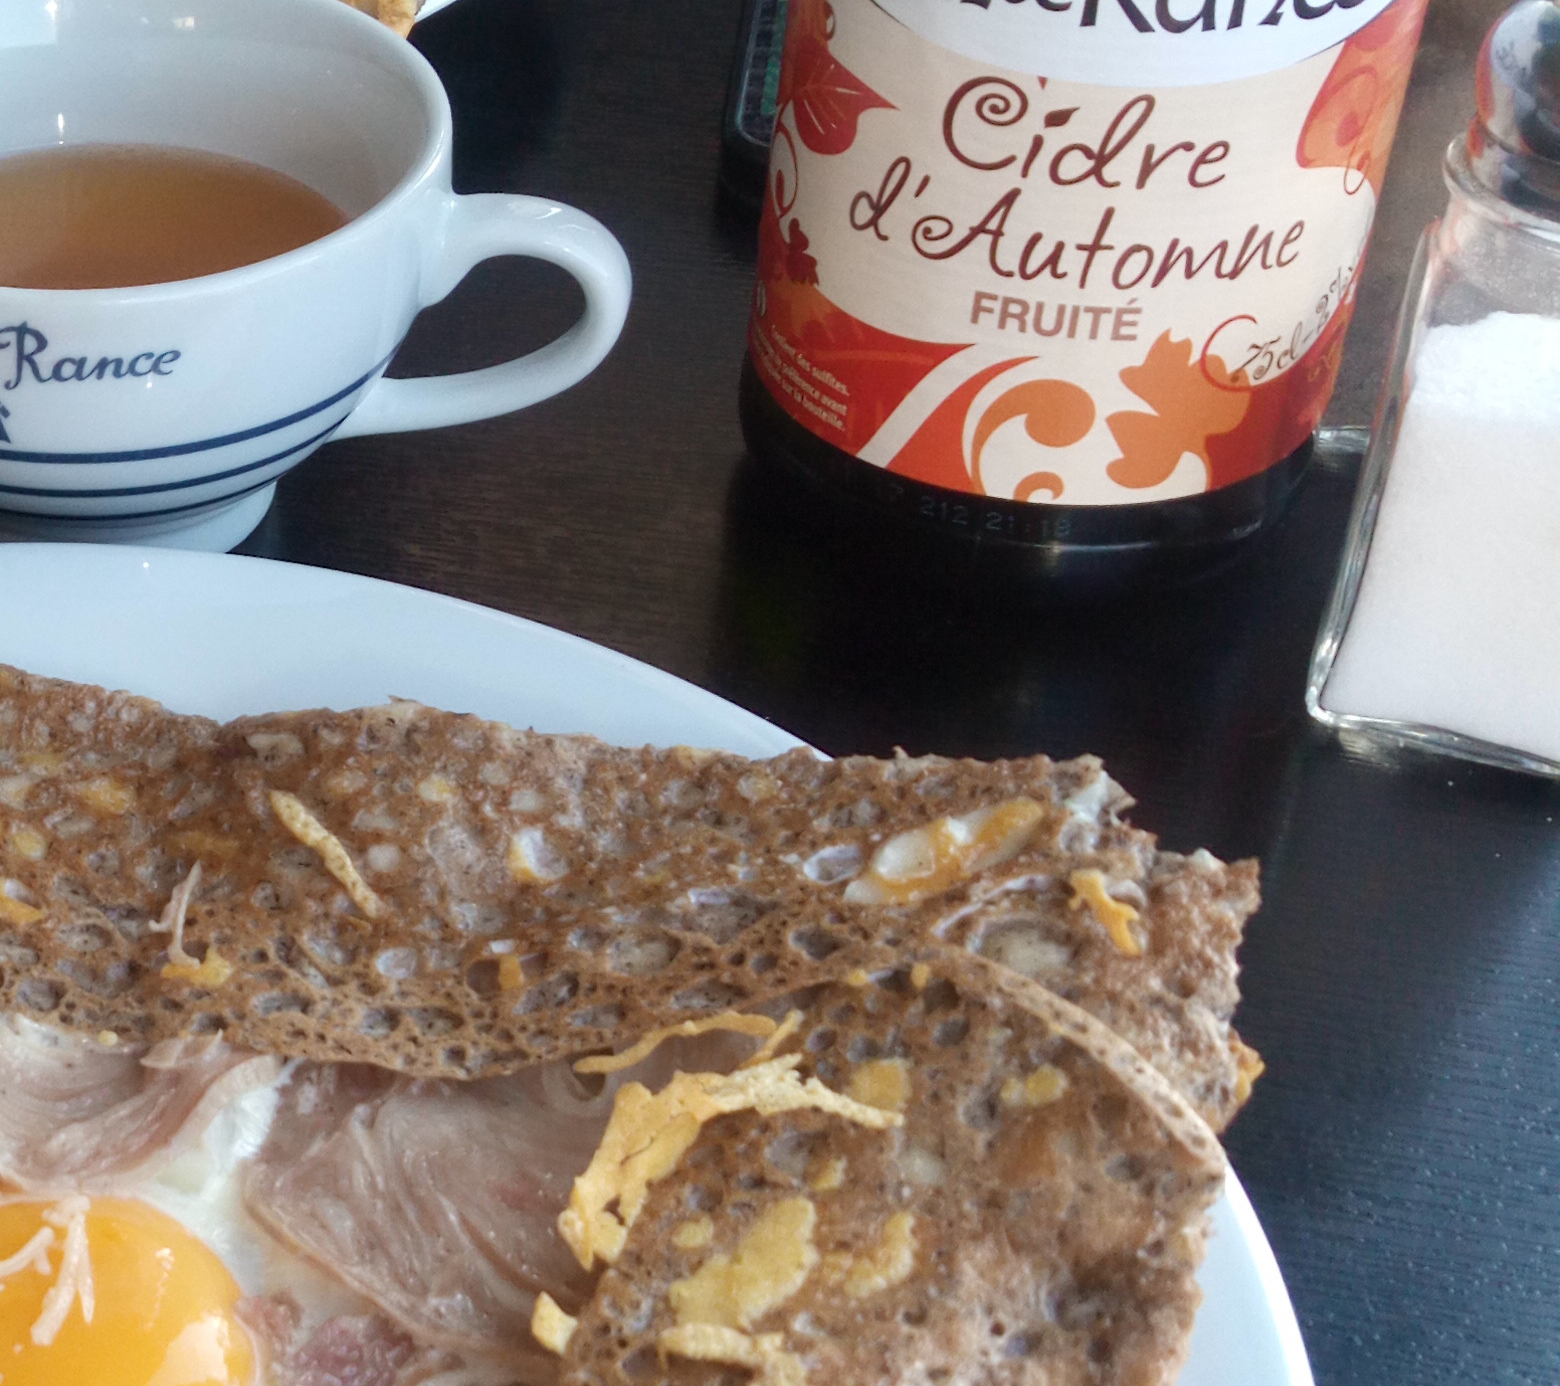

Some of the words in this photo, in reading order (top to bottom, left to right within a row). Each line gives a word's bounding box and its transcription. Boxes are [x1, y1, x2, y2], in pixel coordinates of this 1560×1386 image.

[942, 75, 1229, 190] Cidre
[849, 155, 1306, 290] d'Automne
[970, 291, 1143, 343] FRUITÉ
